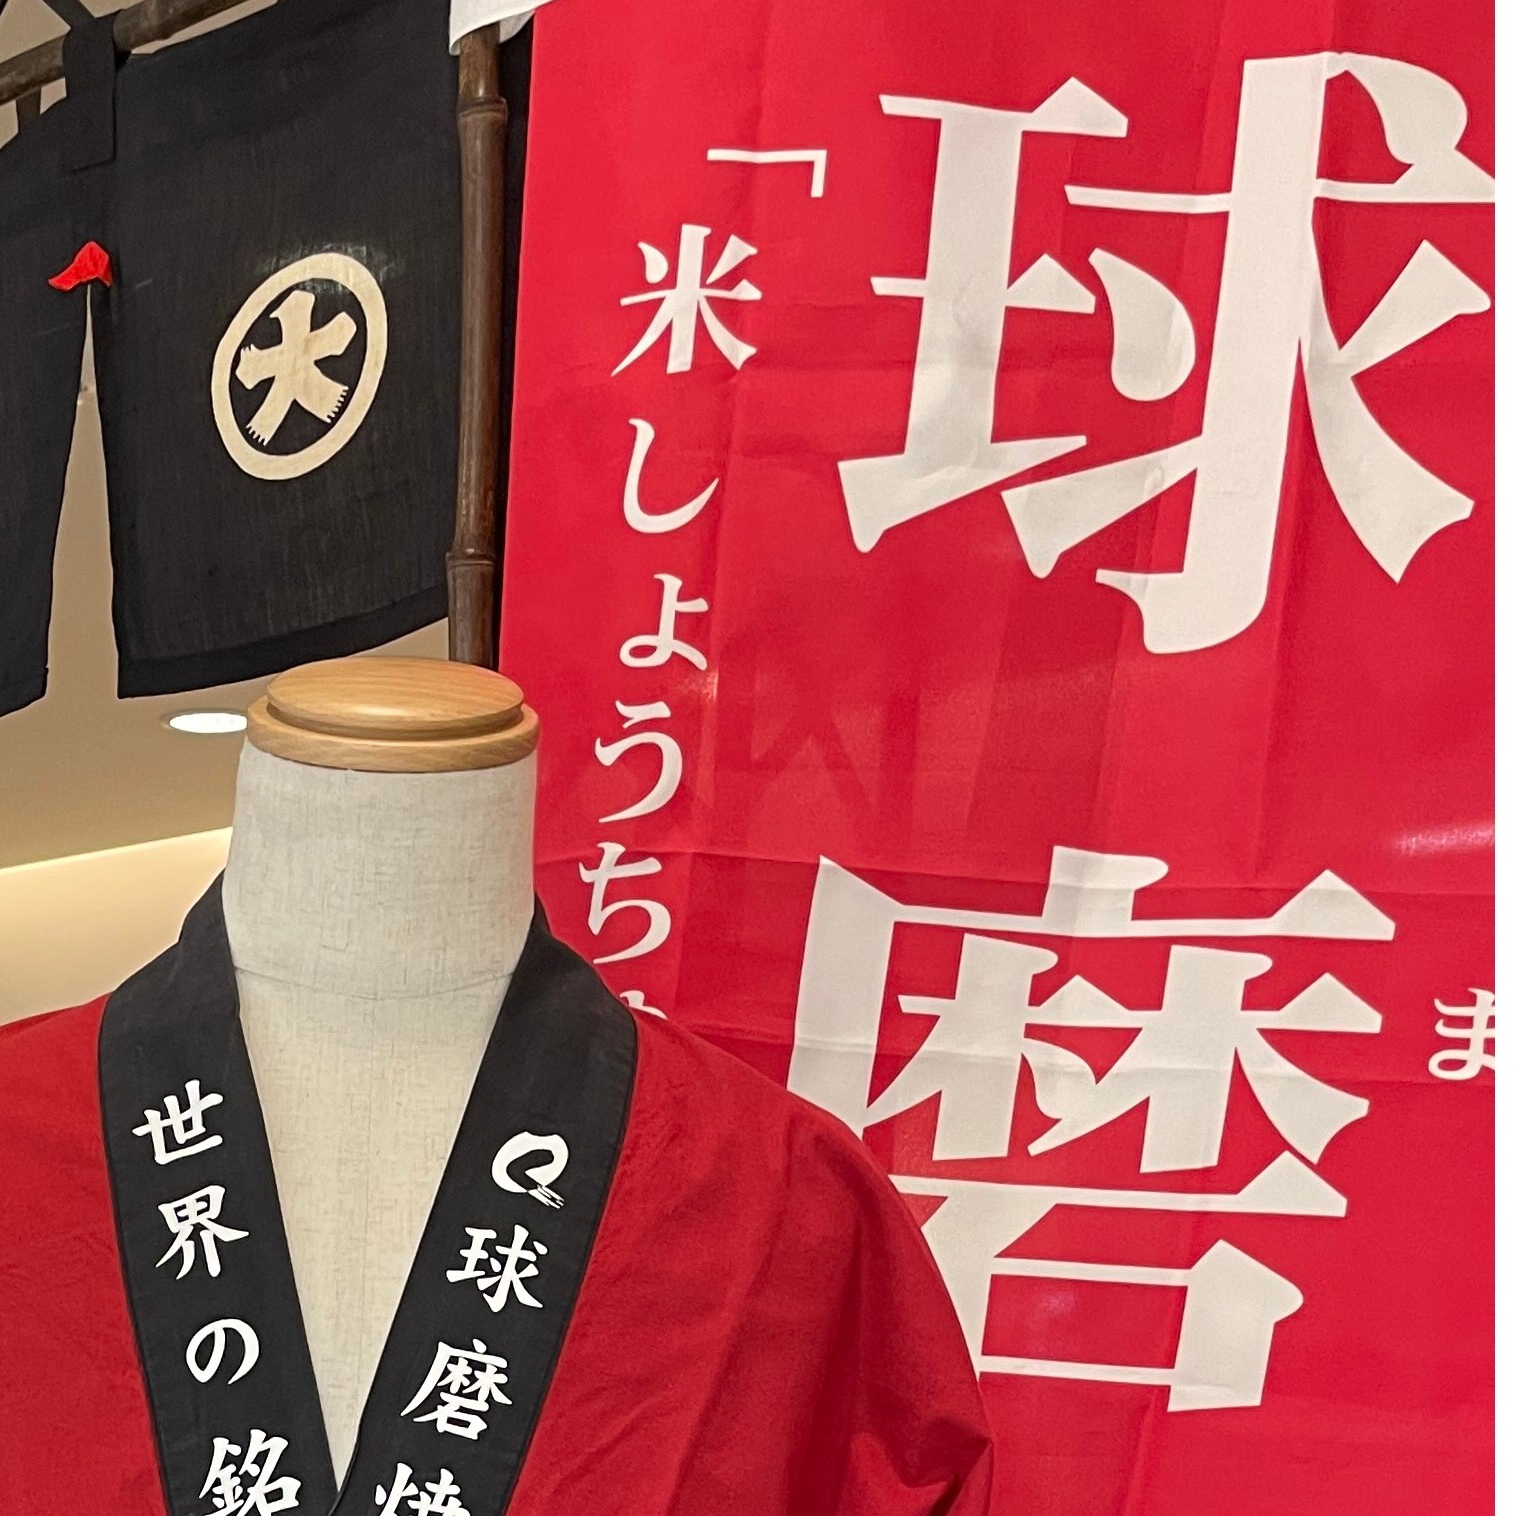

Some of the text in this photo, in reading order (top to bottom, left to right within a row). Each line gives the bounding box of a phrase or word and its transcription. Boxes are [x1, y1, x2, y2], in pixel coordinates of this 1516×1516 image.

[578, 148, 827, 1020] 「米しょうち
